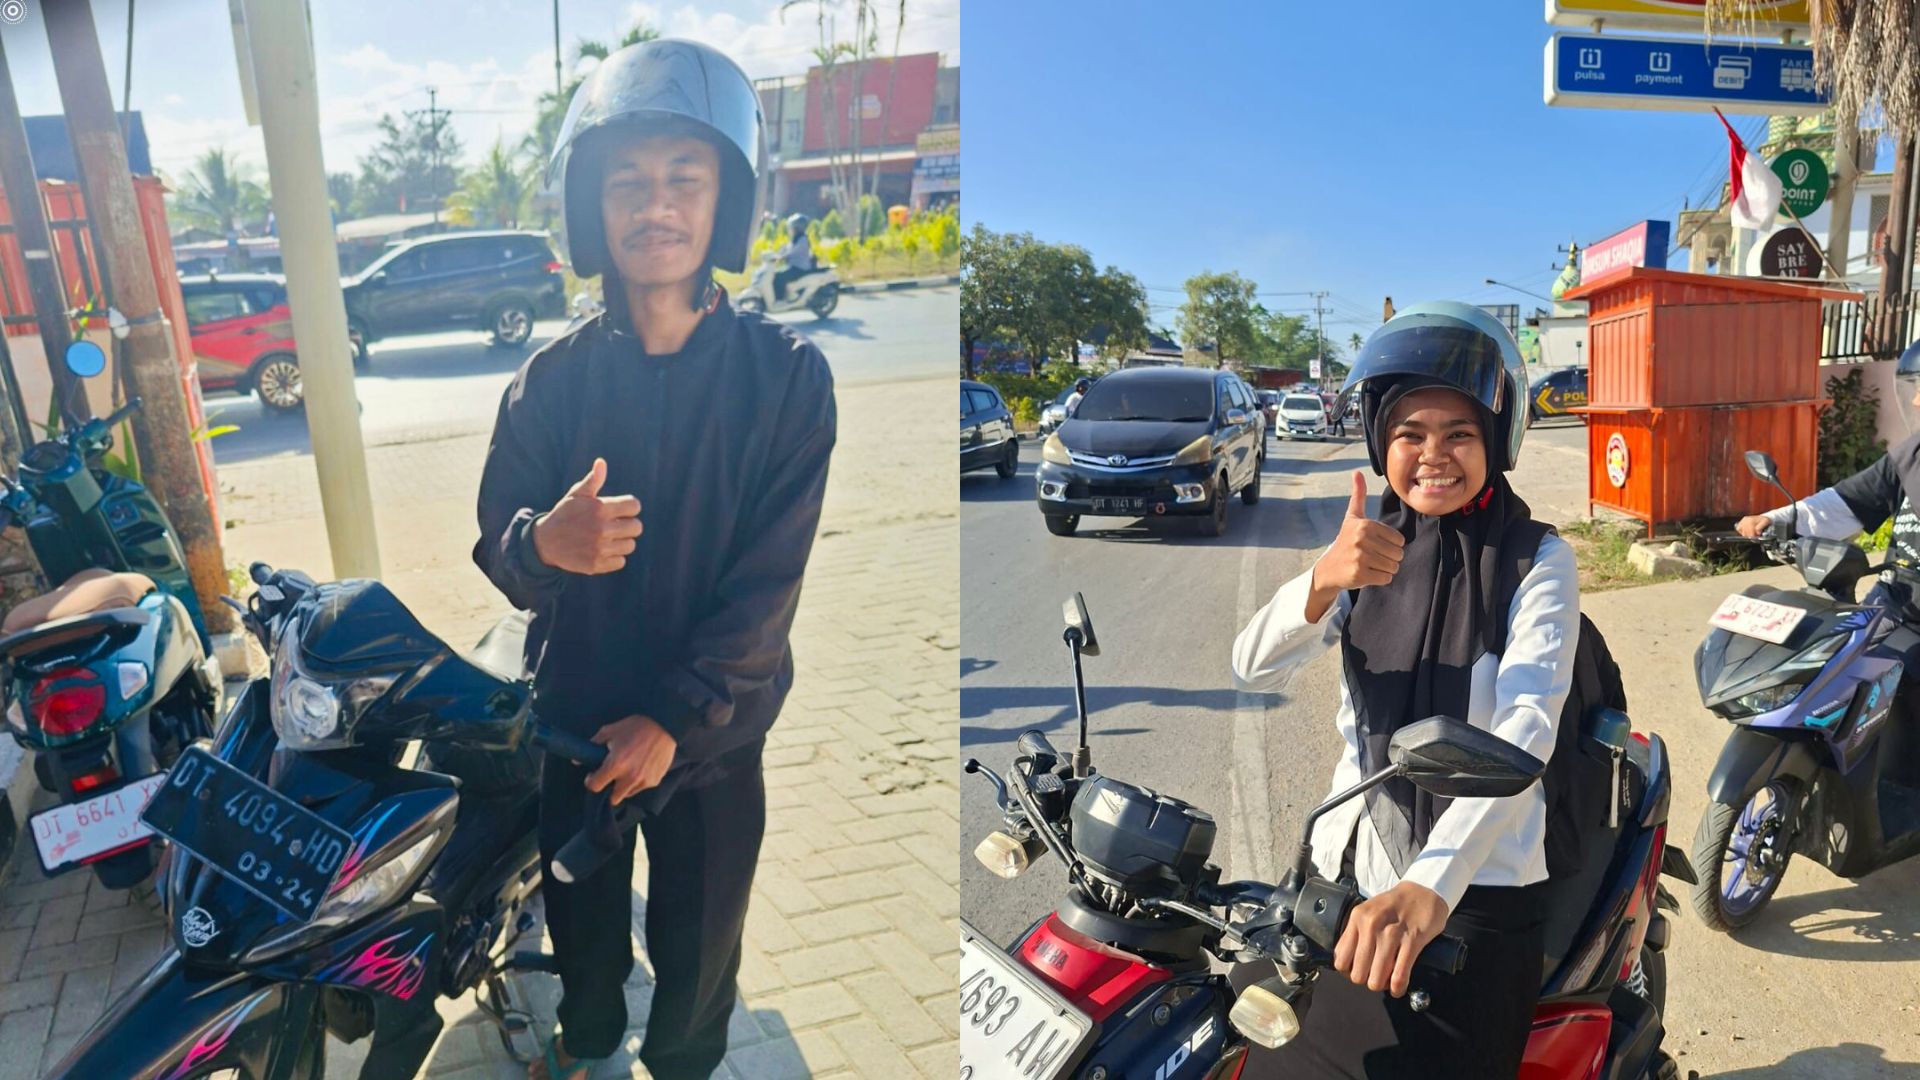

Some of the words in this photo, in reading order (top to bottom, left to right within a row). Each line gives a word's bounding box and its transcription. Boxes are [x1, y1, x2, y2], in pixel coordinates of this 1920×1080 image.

[1780, 58, 1812, 68] PAKE
[1574, 70, 1605, 81] pulsa
[1635, 73, 1683, 85] payment
[1717, 75, 1744, 85] DEBIT
[1777, 242, 1805, 256] SAY
[1778, 255, 1807, 269] BRE
[1563, 391, 1587, 402] POL
[76, 793, 126, 828] 6641
[173, 755, 216, 797] DT
[224, 788, 297, 846] 4094
[301, 827, 343, 875] HD
[1004, 1019, 1071, 1080] AW
